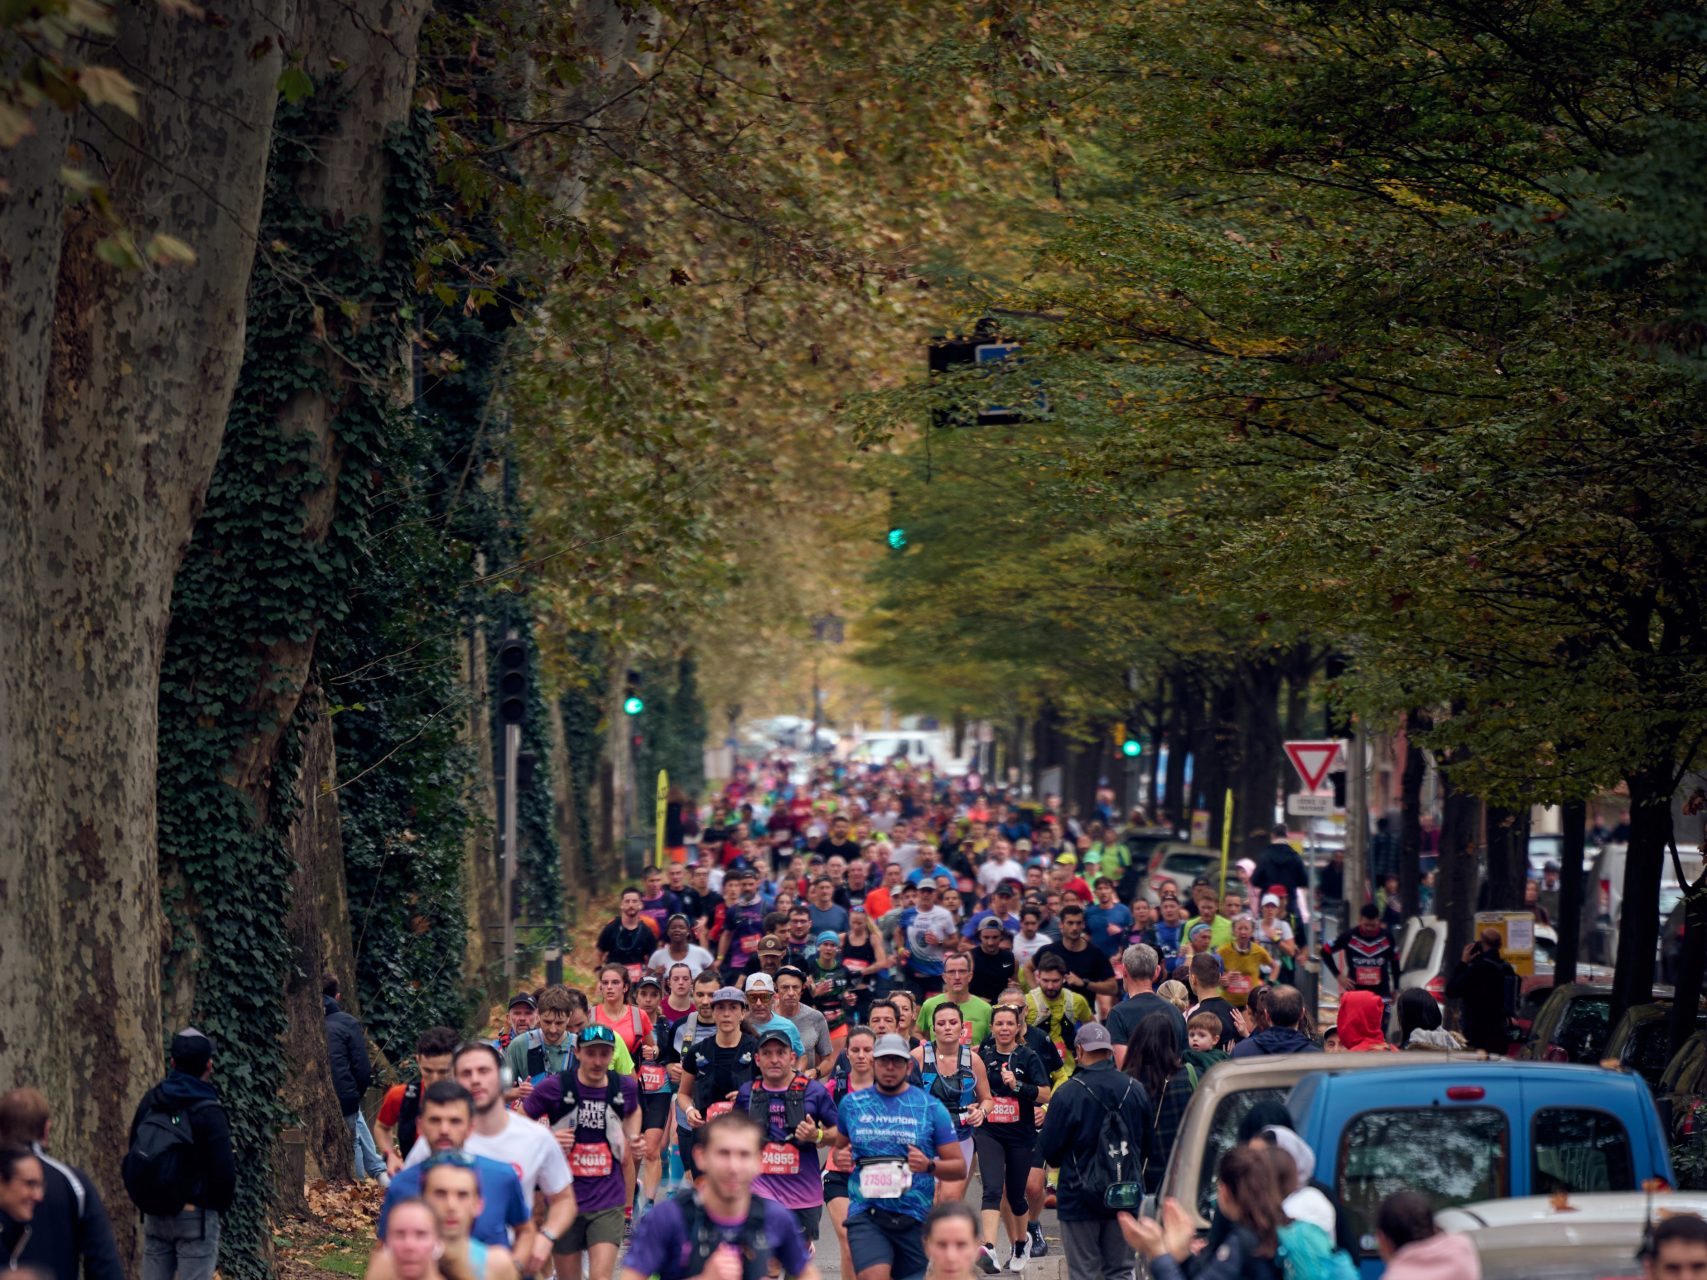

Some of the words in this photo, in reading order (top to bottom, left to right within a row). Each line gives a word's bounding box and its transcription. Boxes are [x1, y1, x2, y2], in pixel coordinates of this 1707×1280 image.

[583, 1100, 605, 1111] THE
[991, 1104, 1015, 1115] 3820
[579, 1108, 605, 1120] ORTH
[876, 1115, 918, 1126] HYUNDAI
[762, 1152, 794, 1165] 24955
